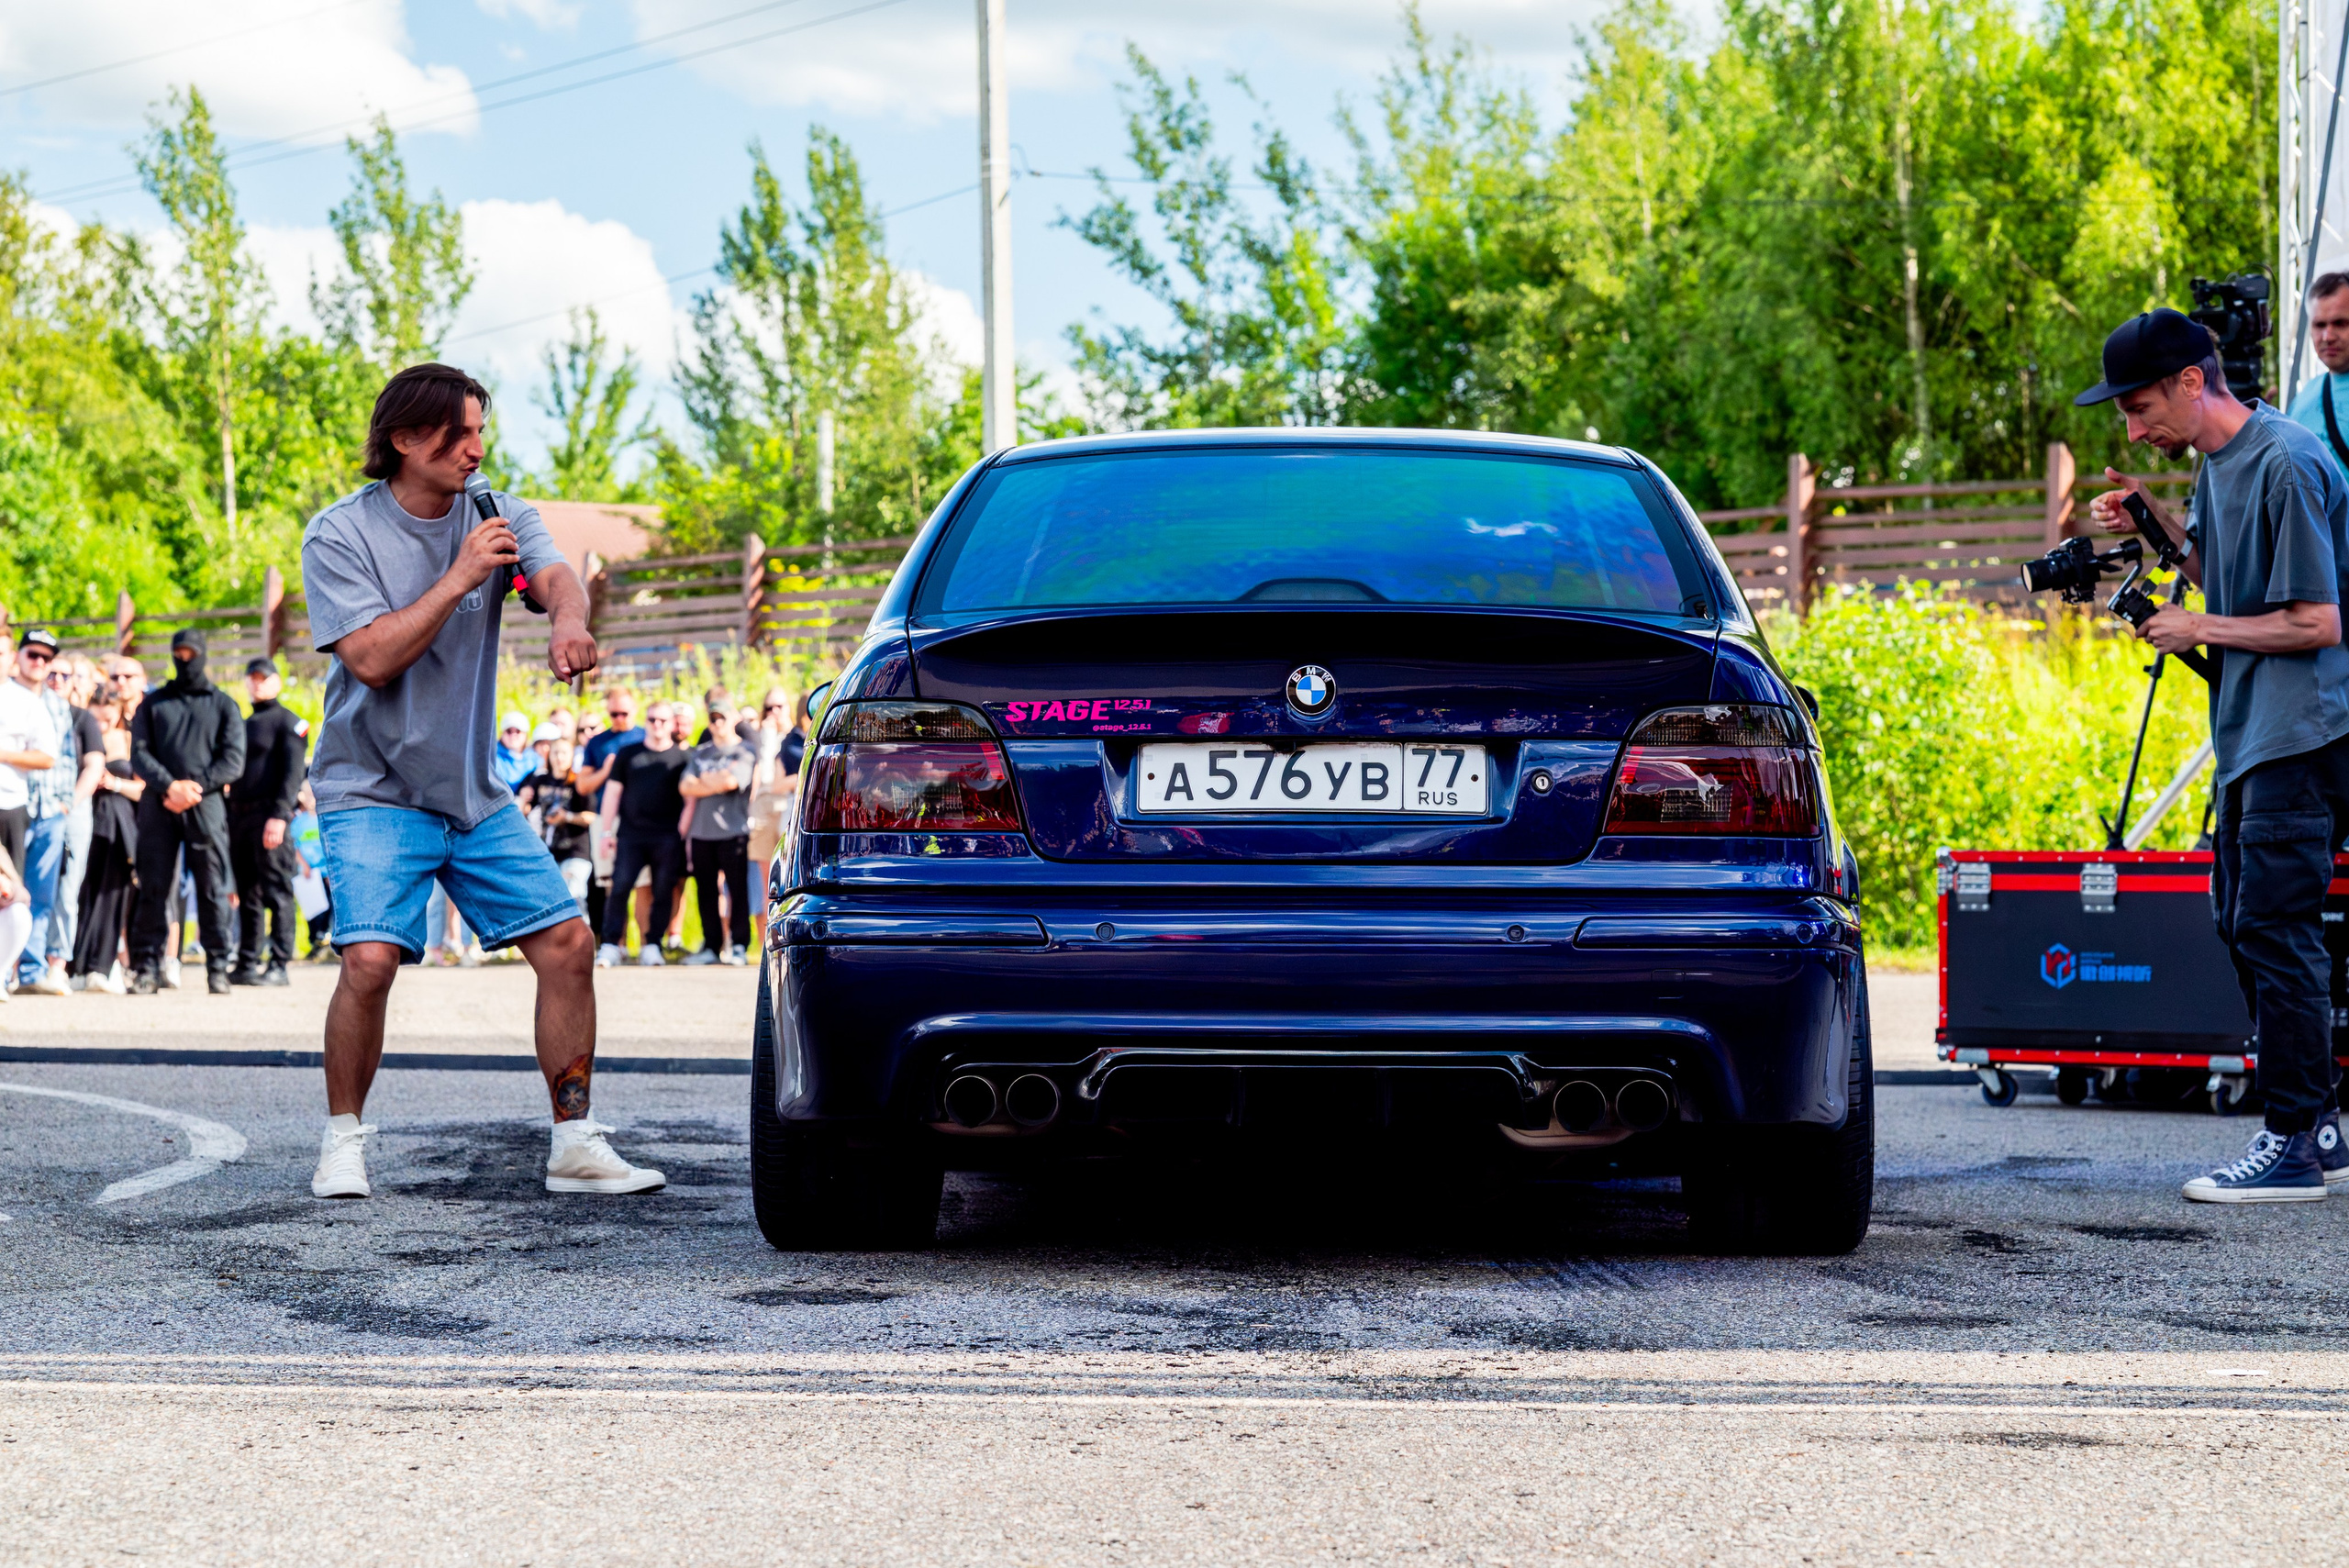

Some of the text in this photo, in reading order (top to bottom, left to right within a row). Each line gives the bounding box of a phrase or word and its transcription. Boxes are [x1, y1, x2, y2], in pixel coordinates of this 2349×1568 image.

[1291, 666, 1332, 683] BMW
[1006, 700, 1111, 722] STAGE
[1411, 749, 1464, 788] 77
[1418, 791, 1458, 806] RUS
